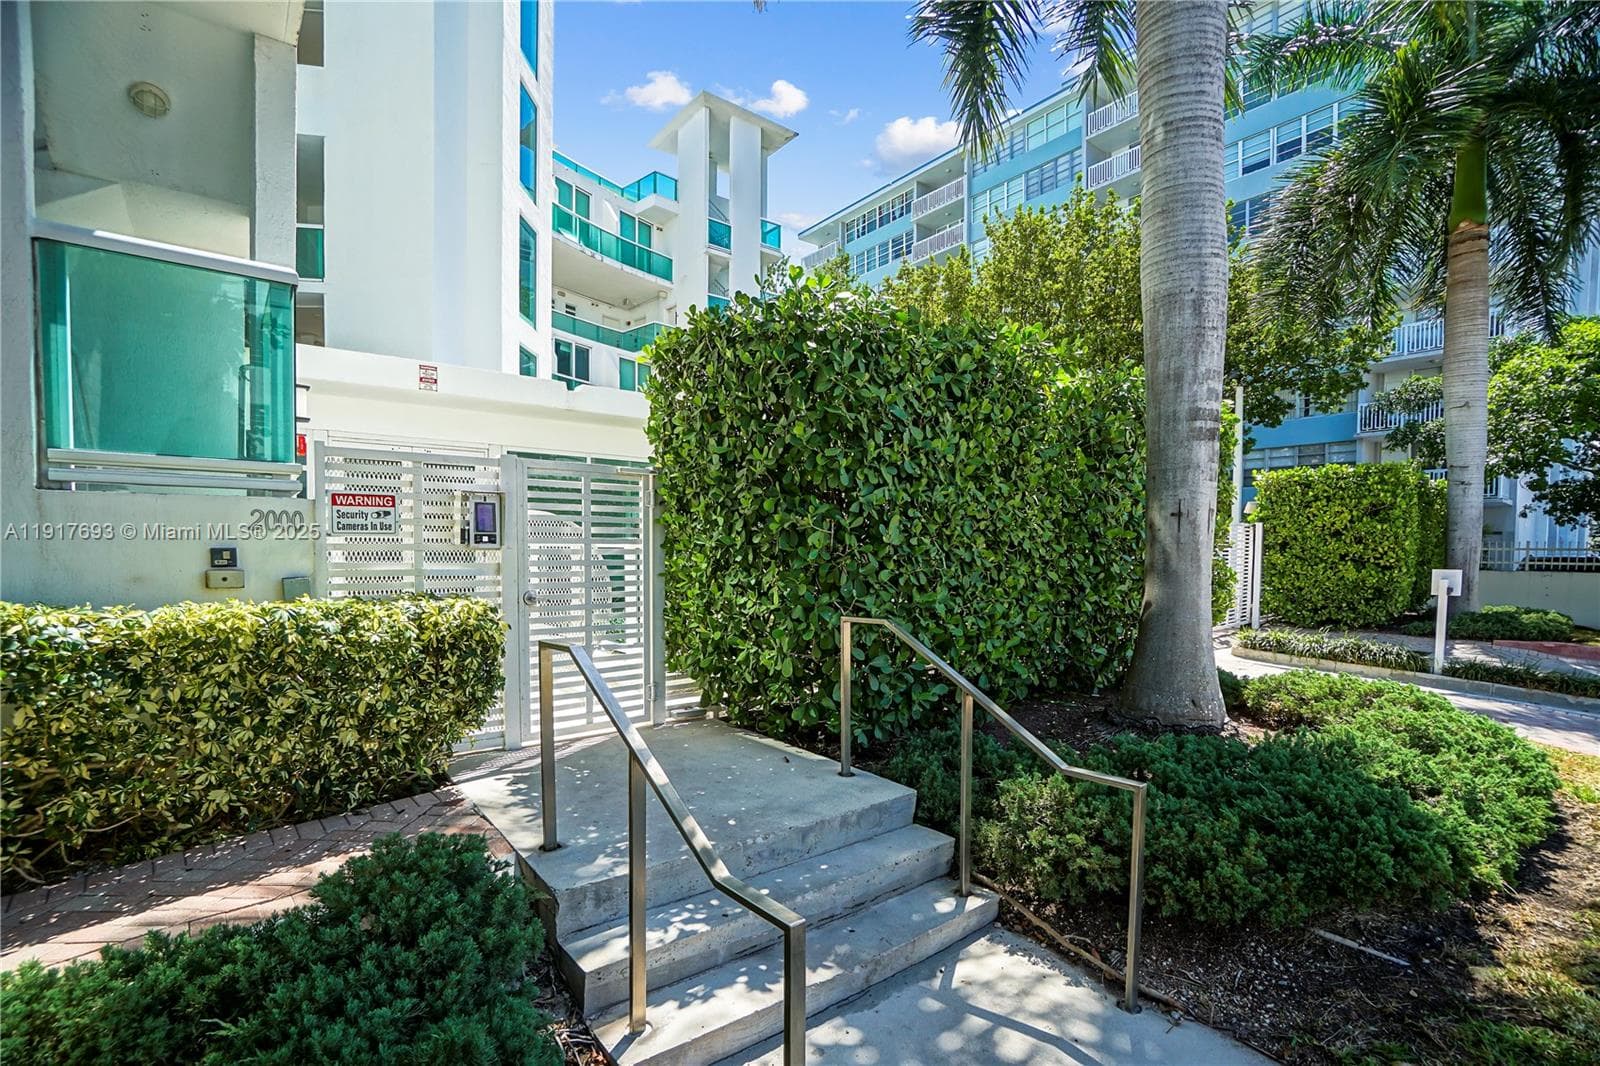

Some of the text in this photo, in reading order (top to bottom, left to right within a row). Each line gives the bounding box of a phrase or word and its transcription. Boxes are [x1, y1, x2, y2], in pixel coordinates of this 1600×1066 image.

[335, 495, 393, 506] WARNING
[336, 509, 369, 521] Security
[248, 509, 304, 533] 2000
[336, 521, 392, 531] Cameras In Use
